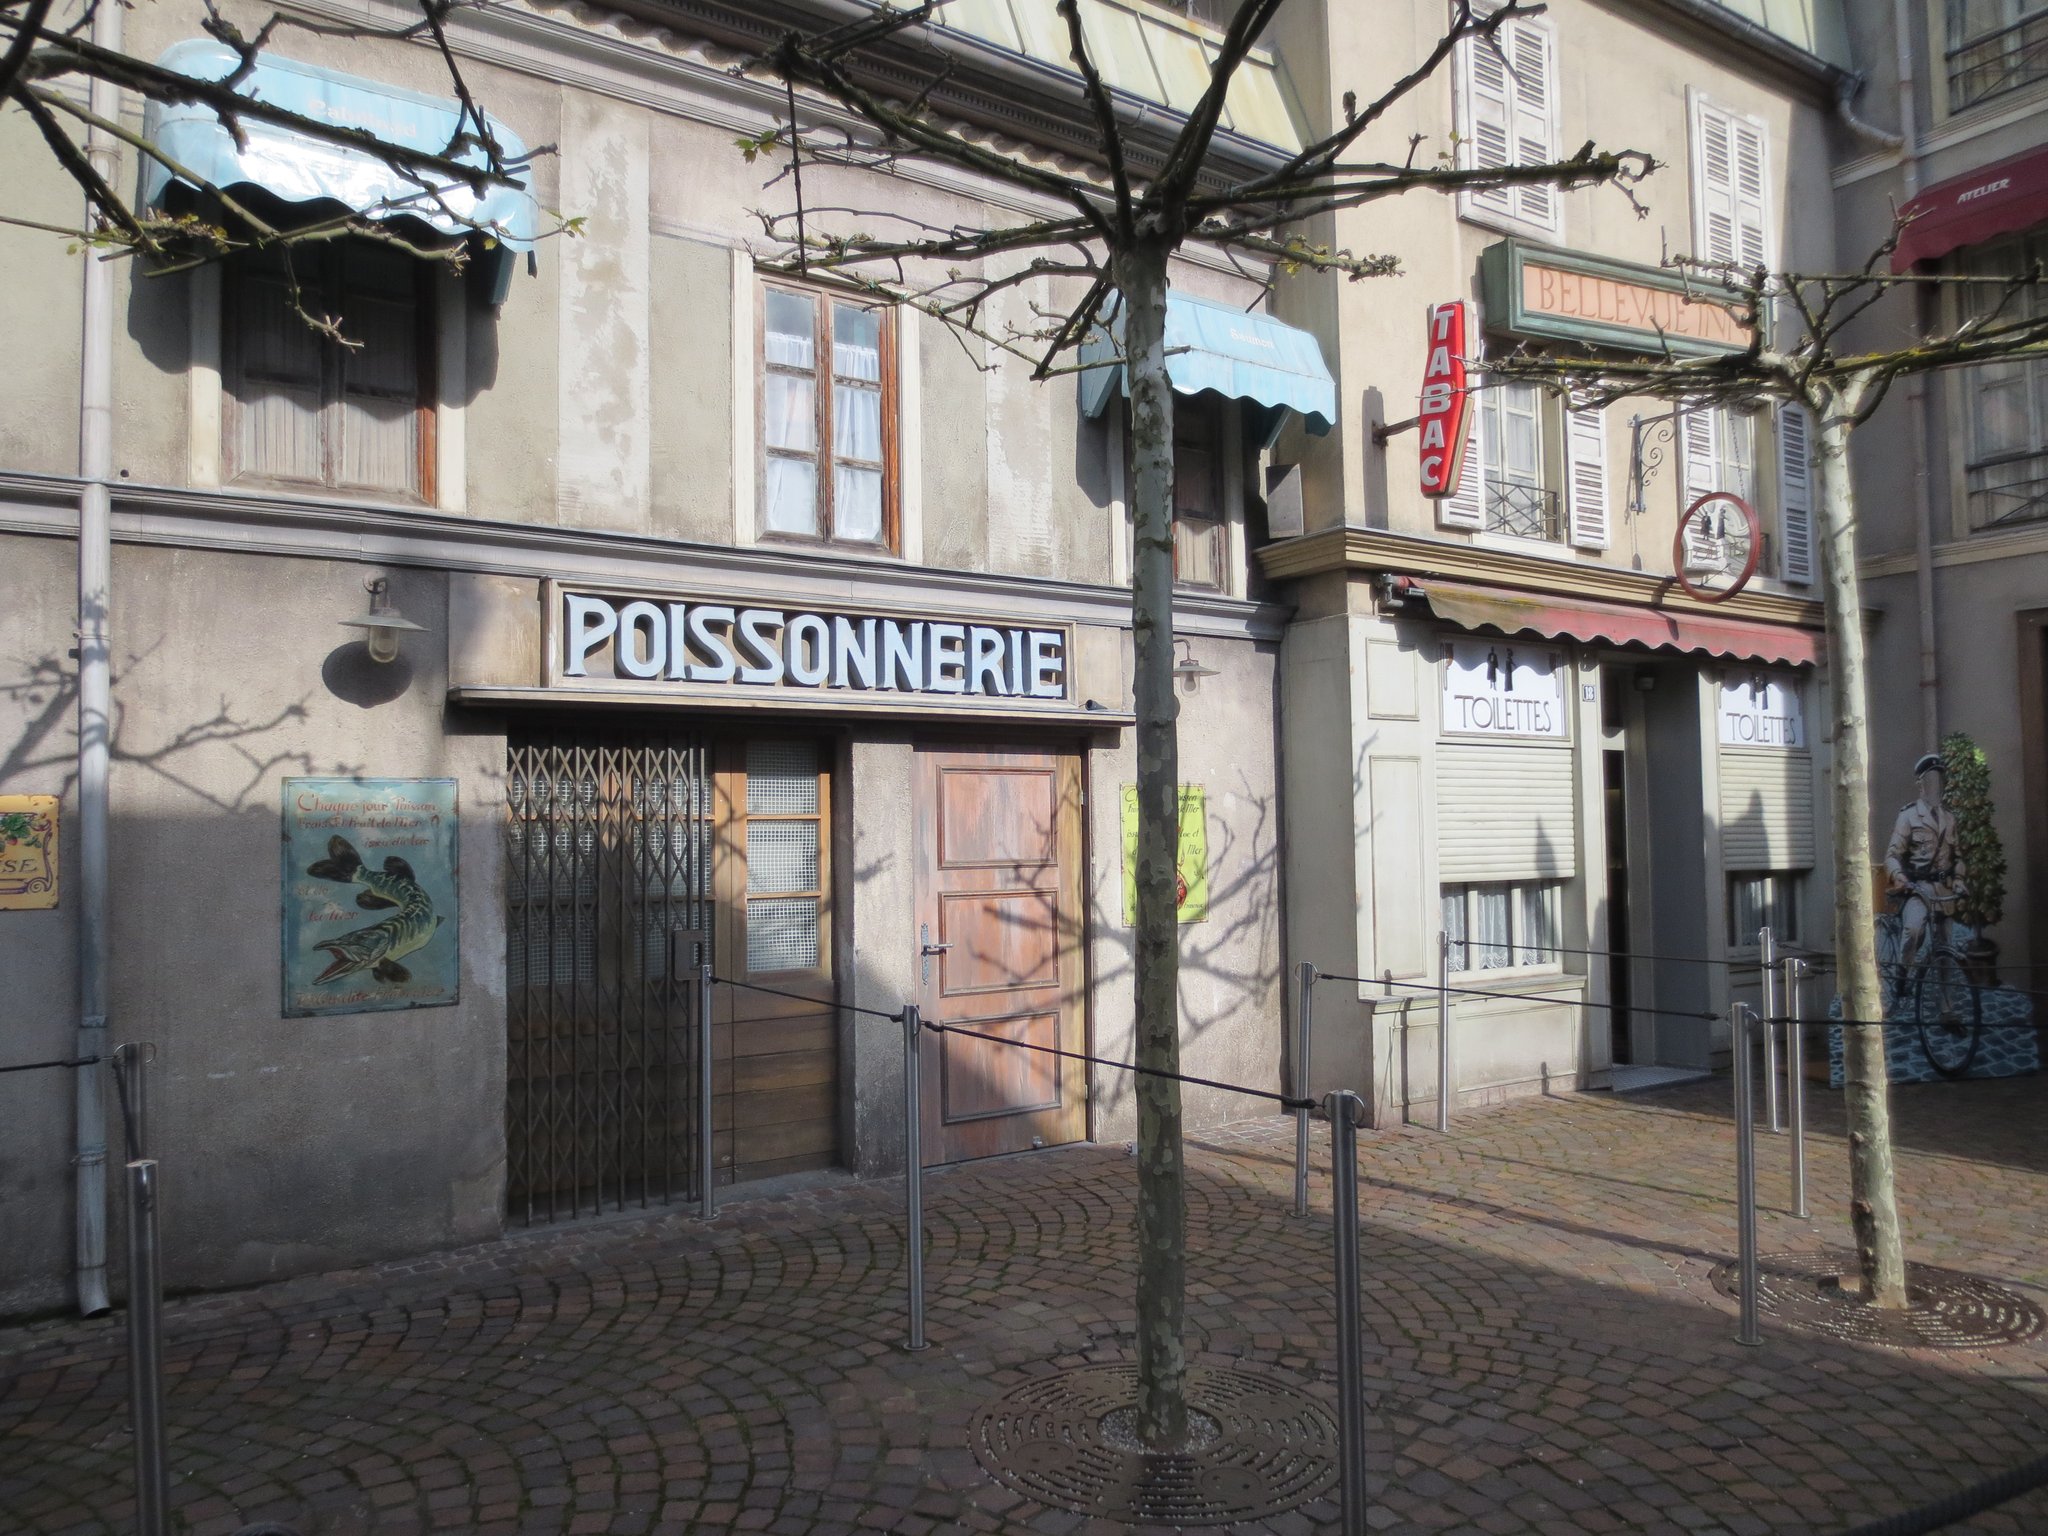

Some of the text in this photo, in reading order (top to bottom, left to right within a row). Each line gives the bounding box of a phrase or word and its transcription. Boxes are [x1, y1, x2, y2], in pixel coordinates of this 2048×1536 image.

[1956, 178, 2010, 204] ATELIER
[1539, 269, 1688, 333] BELLEVUE
[1419, 309, 1455, 487] TABAC
[564, 593, 1063, 698] POISSONNERIE
[1454, 694, 1552, 732] TOILETTES
[1725, 712, 1797, 745] TOILETTES
[296, 793, 358, 817] Chaque
[361, 798, 388, 816] jour
